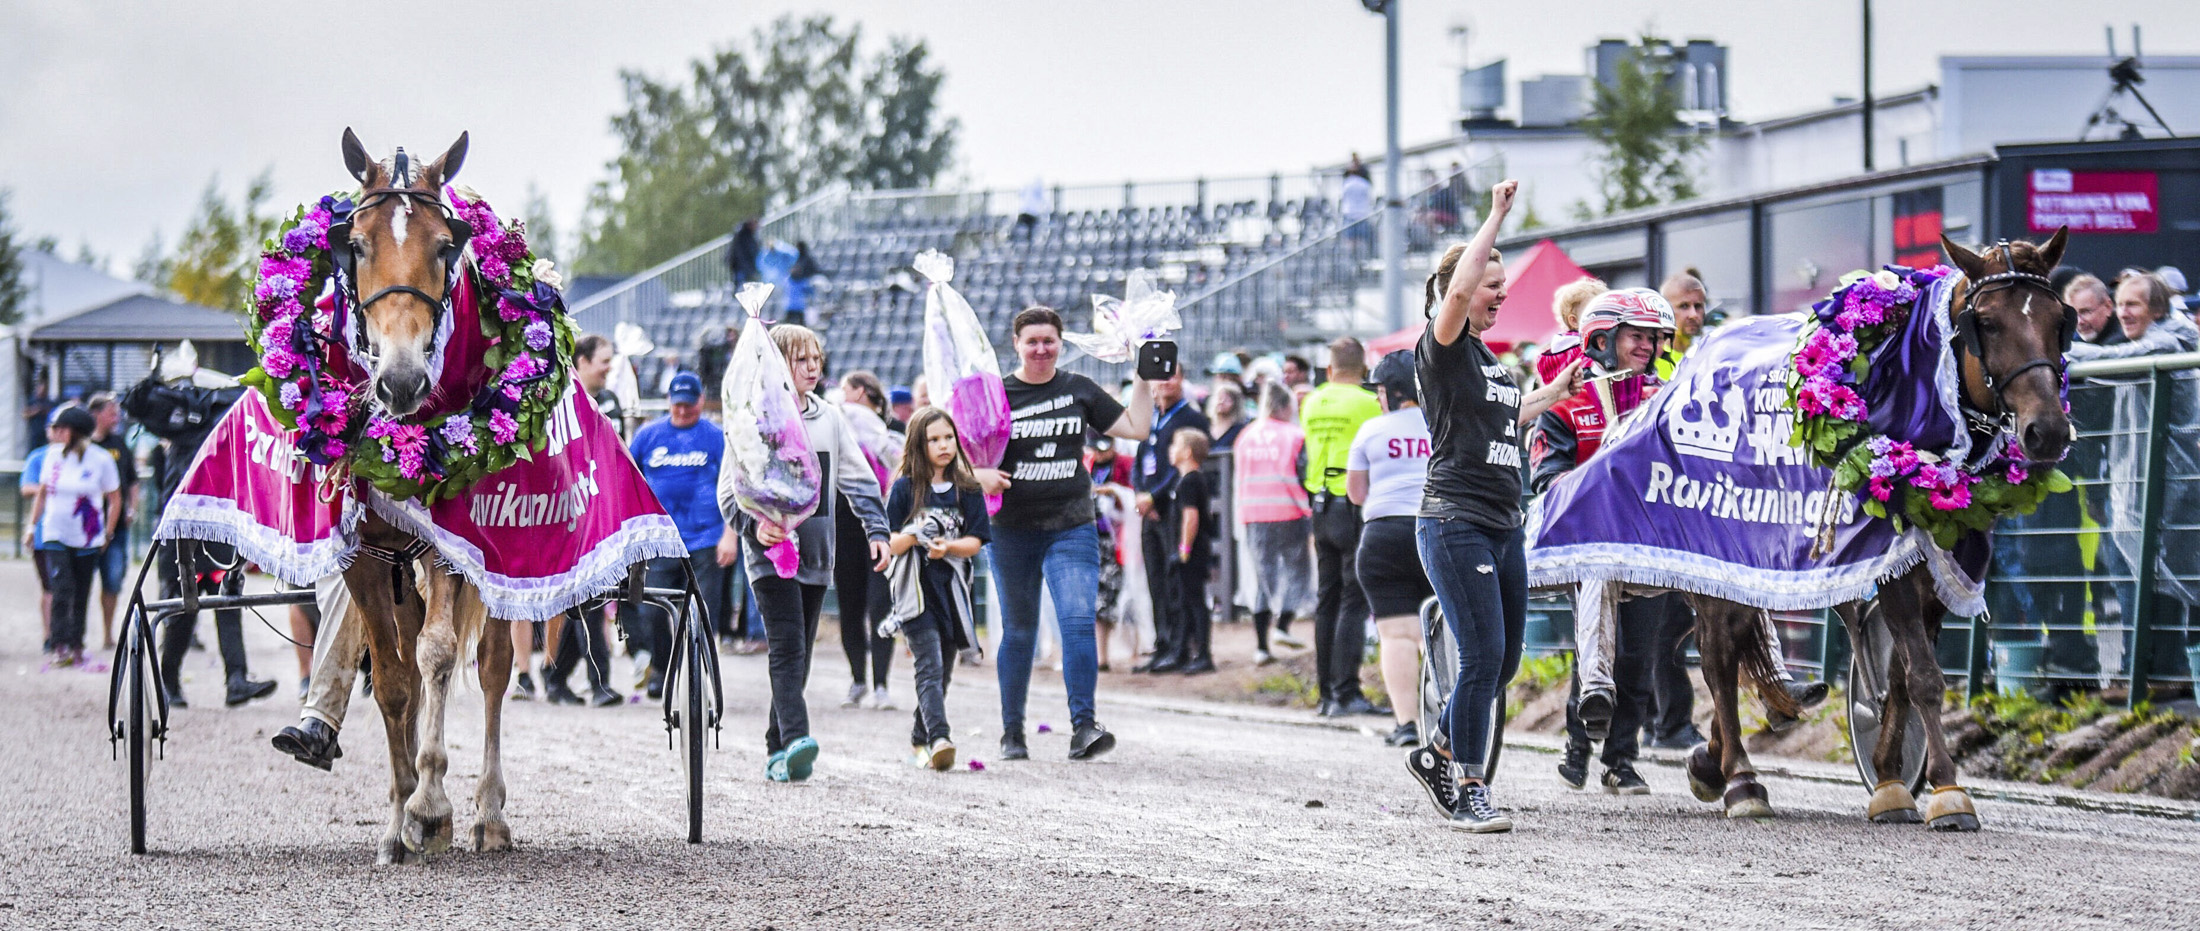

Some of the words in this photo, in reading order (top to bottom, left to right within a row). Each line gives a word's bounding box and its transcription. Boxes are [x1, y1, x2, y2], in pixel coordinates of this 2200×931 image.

[1010, 416, 1081, 440] EVARTTI
[648, 446, 708, 468] Evartti
[1035, 442, 1057, 458] JA
[1645, 461, 1855, 537] Ravikuningas
